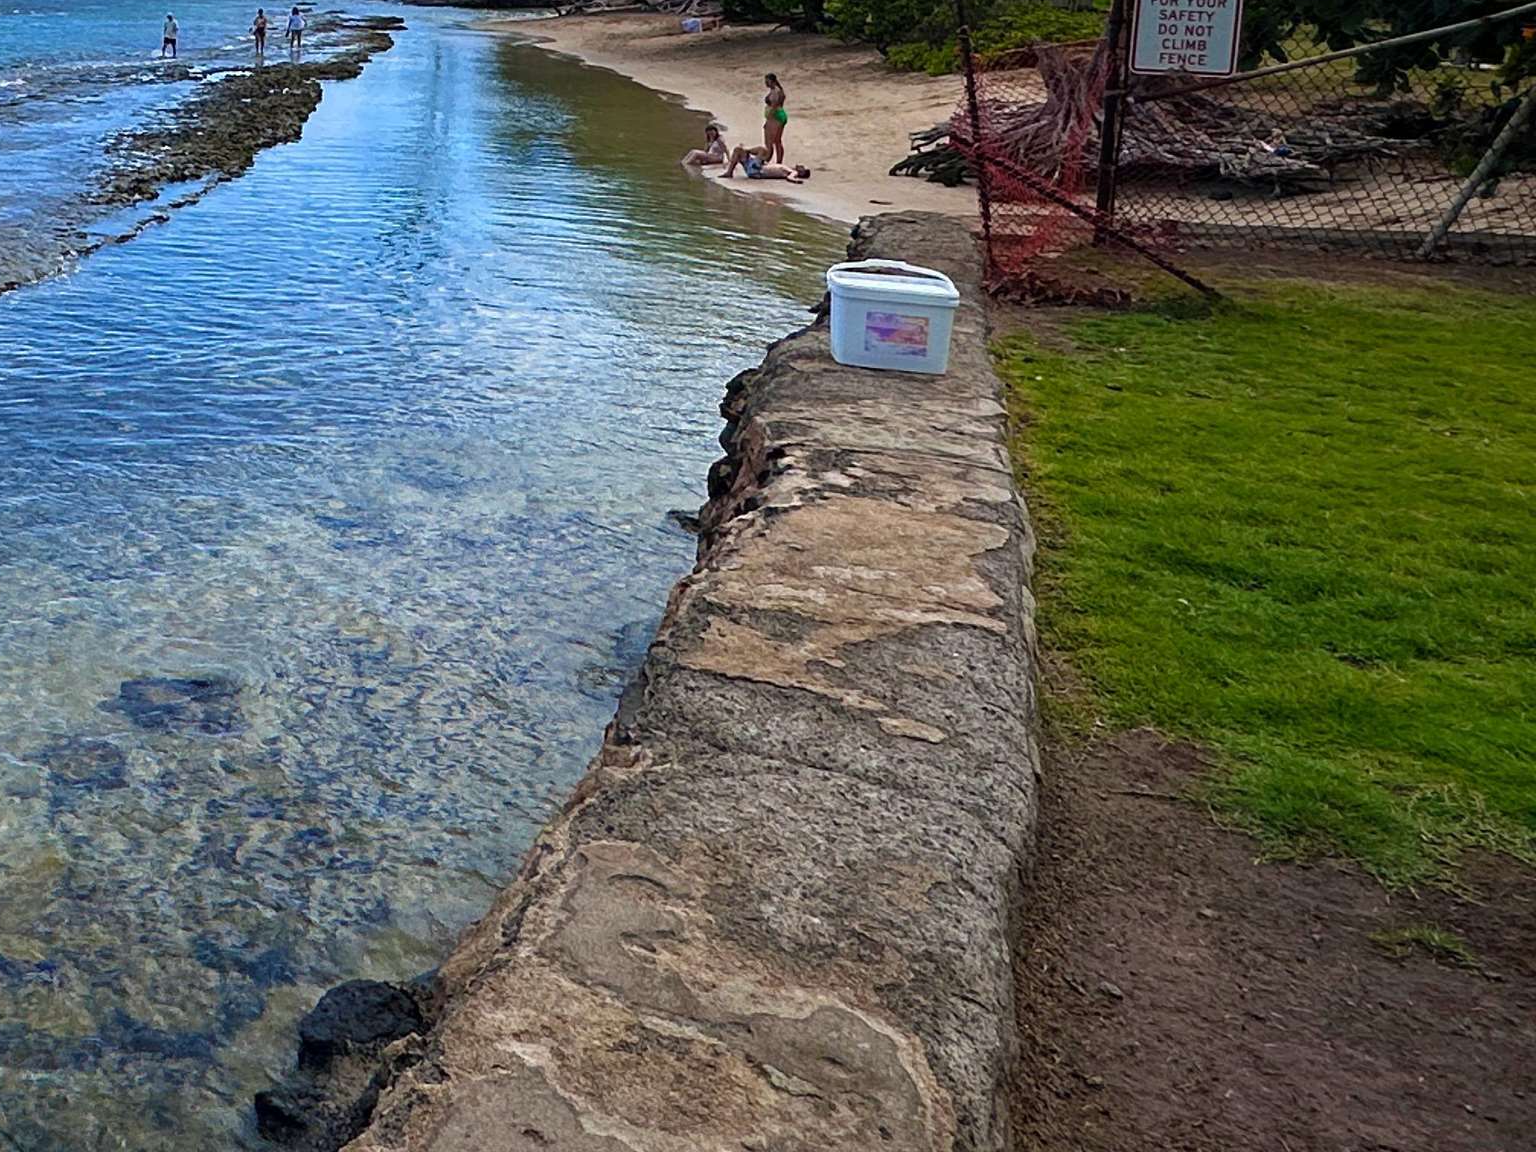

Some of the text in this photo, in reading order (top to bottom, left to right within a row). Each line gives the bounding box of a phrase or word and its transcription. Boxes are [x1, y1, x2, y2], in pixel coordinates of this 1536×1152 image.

[1159, 10, 1215, 22] SAFETY
[1158, 24, 1214, 36] DO NOT
[1162, 39, 1207, 51] CLIMB
[1159, 53, 1208, 66] FENCE
